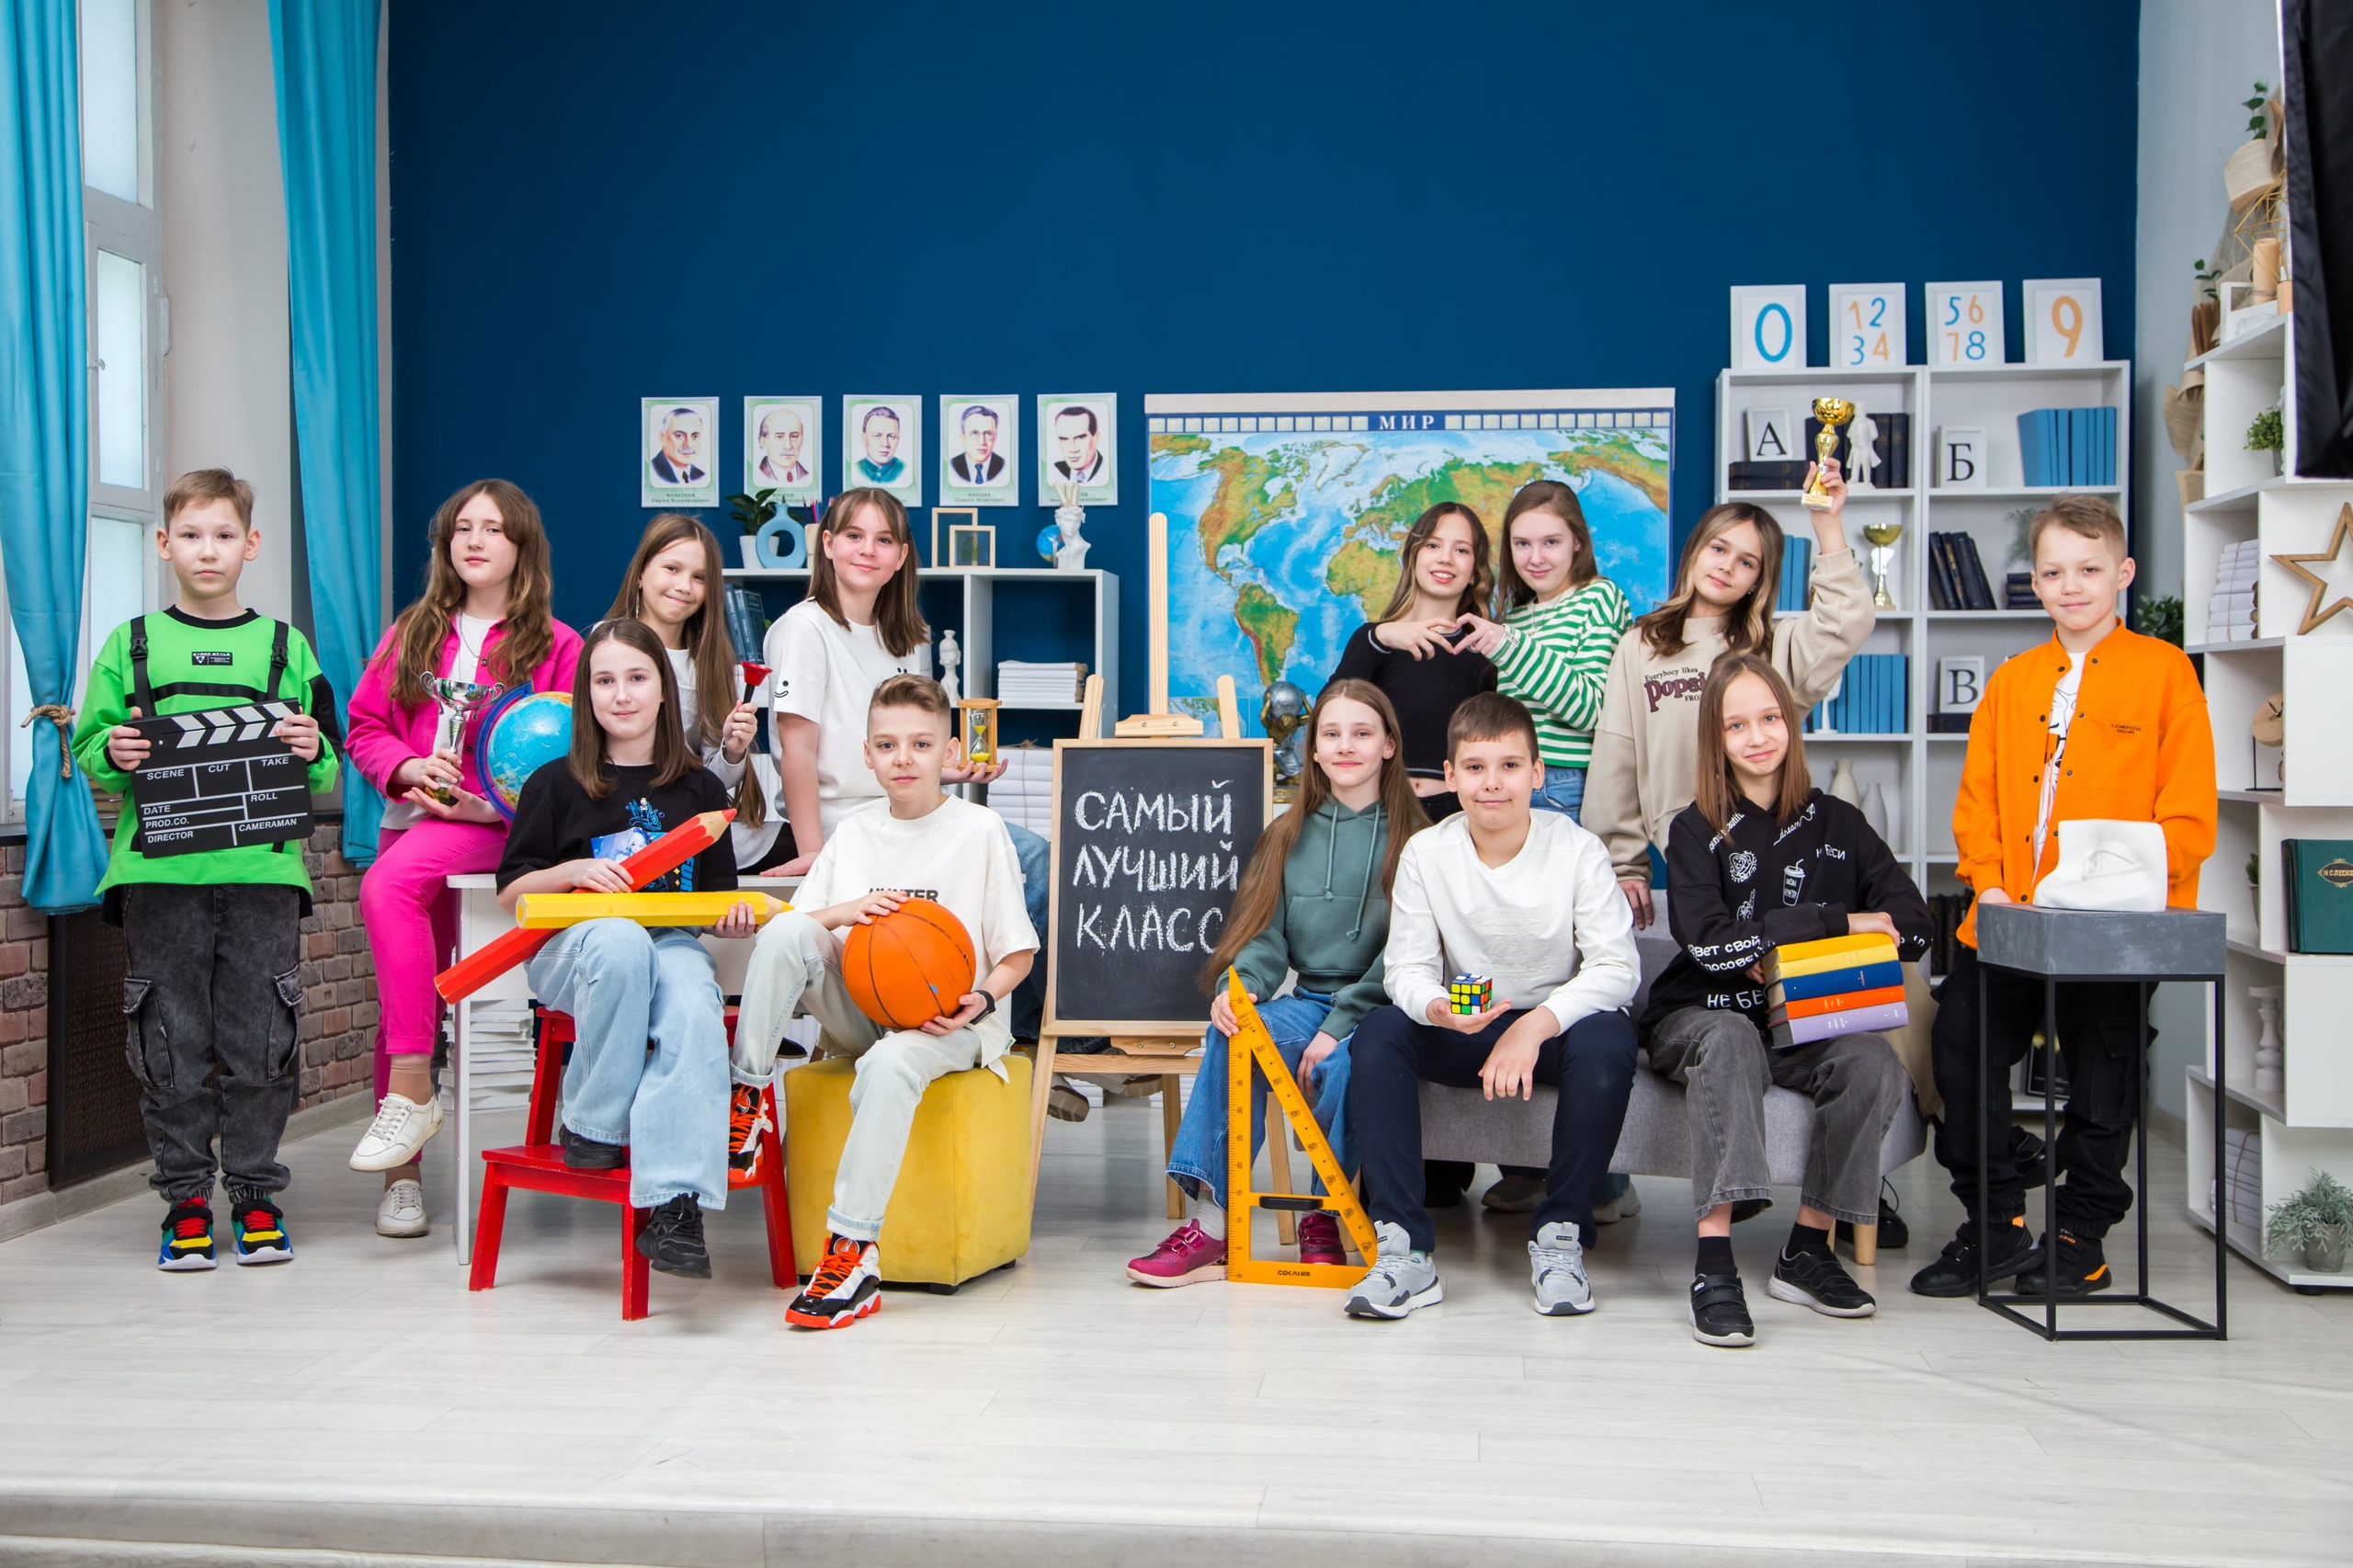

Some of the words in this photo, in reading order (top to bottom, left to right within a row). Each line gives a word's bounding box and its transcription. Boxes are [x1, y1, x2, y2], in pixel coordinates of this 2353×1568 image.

[1755, 302, 1792, 363] 0
[2051, 295, 2084, 358] 9
[1379, 415, 1435, 430] МИР
[1947, 443, 1976, 482] Б
[1685, 694, 1701, 702] FRO
[208, 764, 231, 773] CUT
[261, 756, 290, 767] TAKE
[146, 768, 185, 780] SCENE
[250, 792, 278, 802] ROLL
[143, 805, 171, 815] DATE
[1074, 779, 1233, 835] САМЫЙ
[145, 817, 189, 828] PROD.CO.
[239, 818, 297, 832] CAMERAMAN
[147, 831, 194, 844] DIRECTOR
[1073, 840, 1239, 892] ЛУЧШИЙ
[1076, 903, 1223, 954] КЛАСС
[1707, 994, 1731, 1008] НЕ
